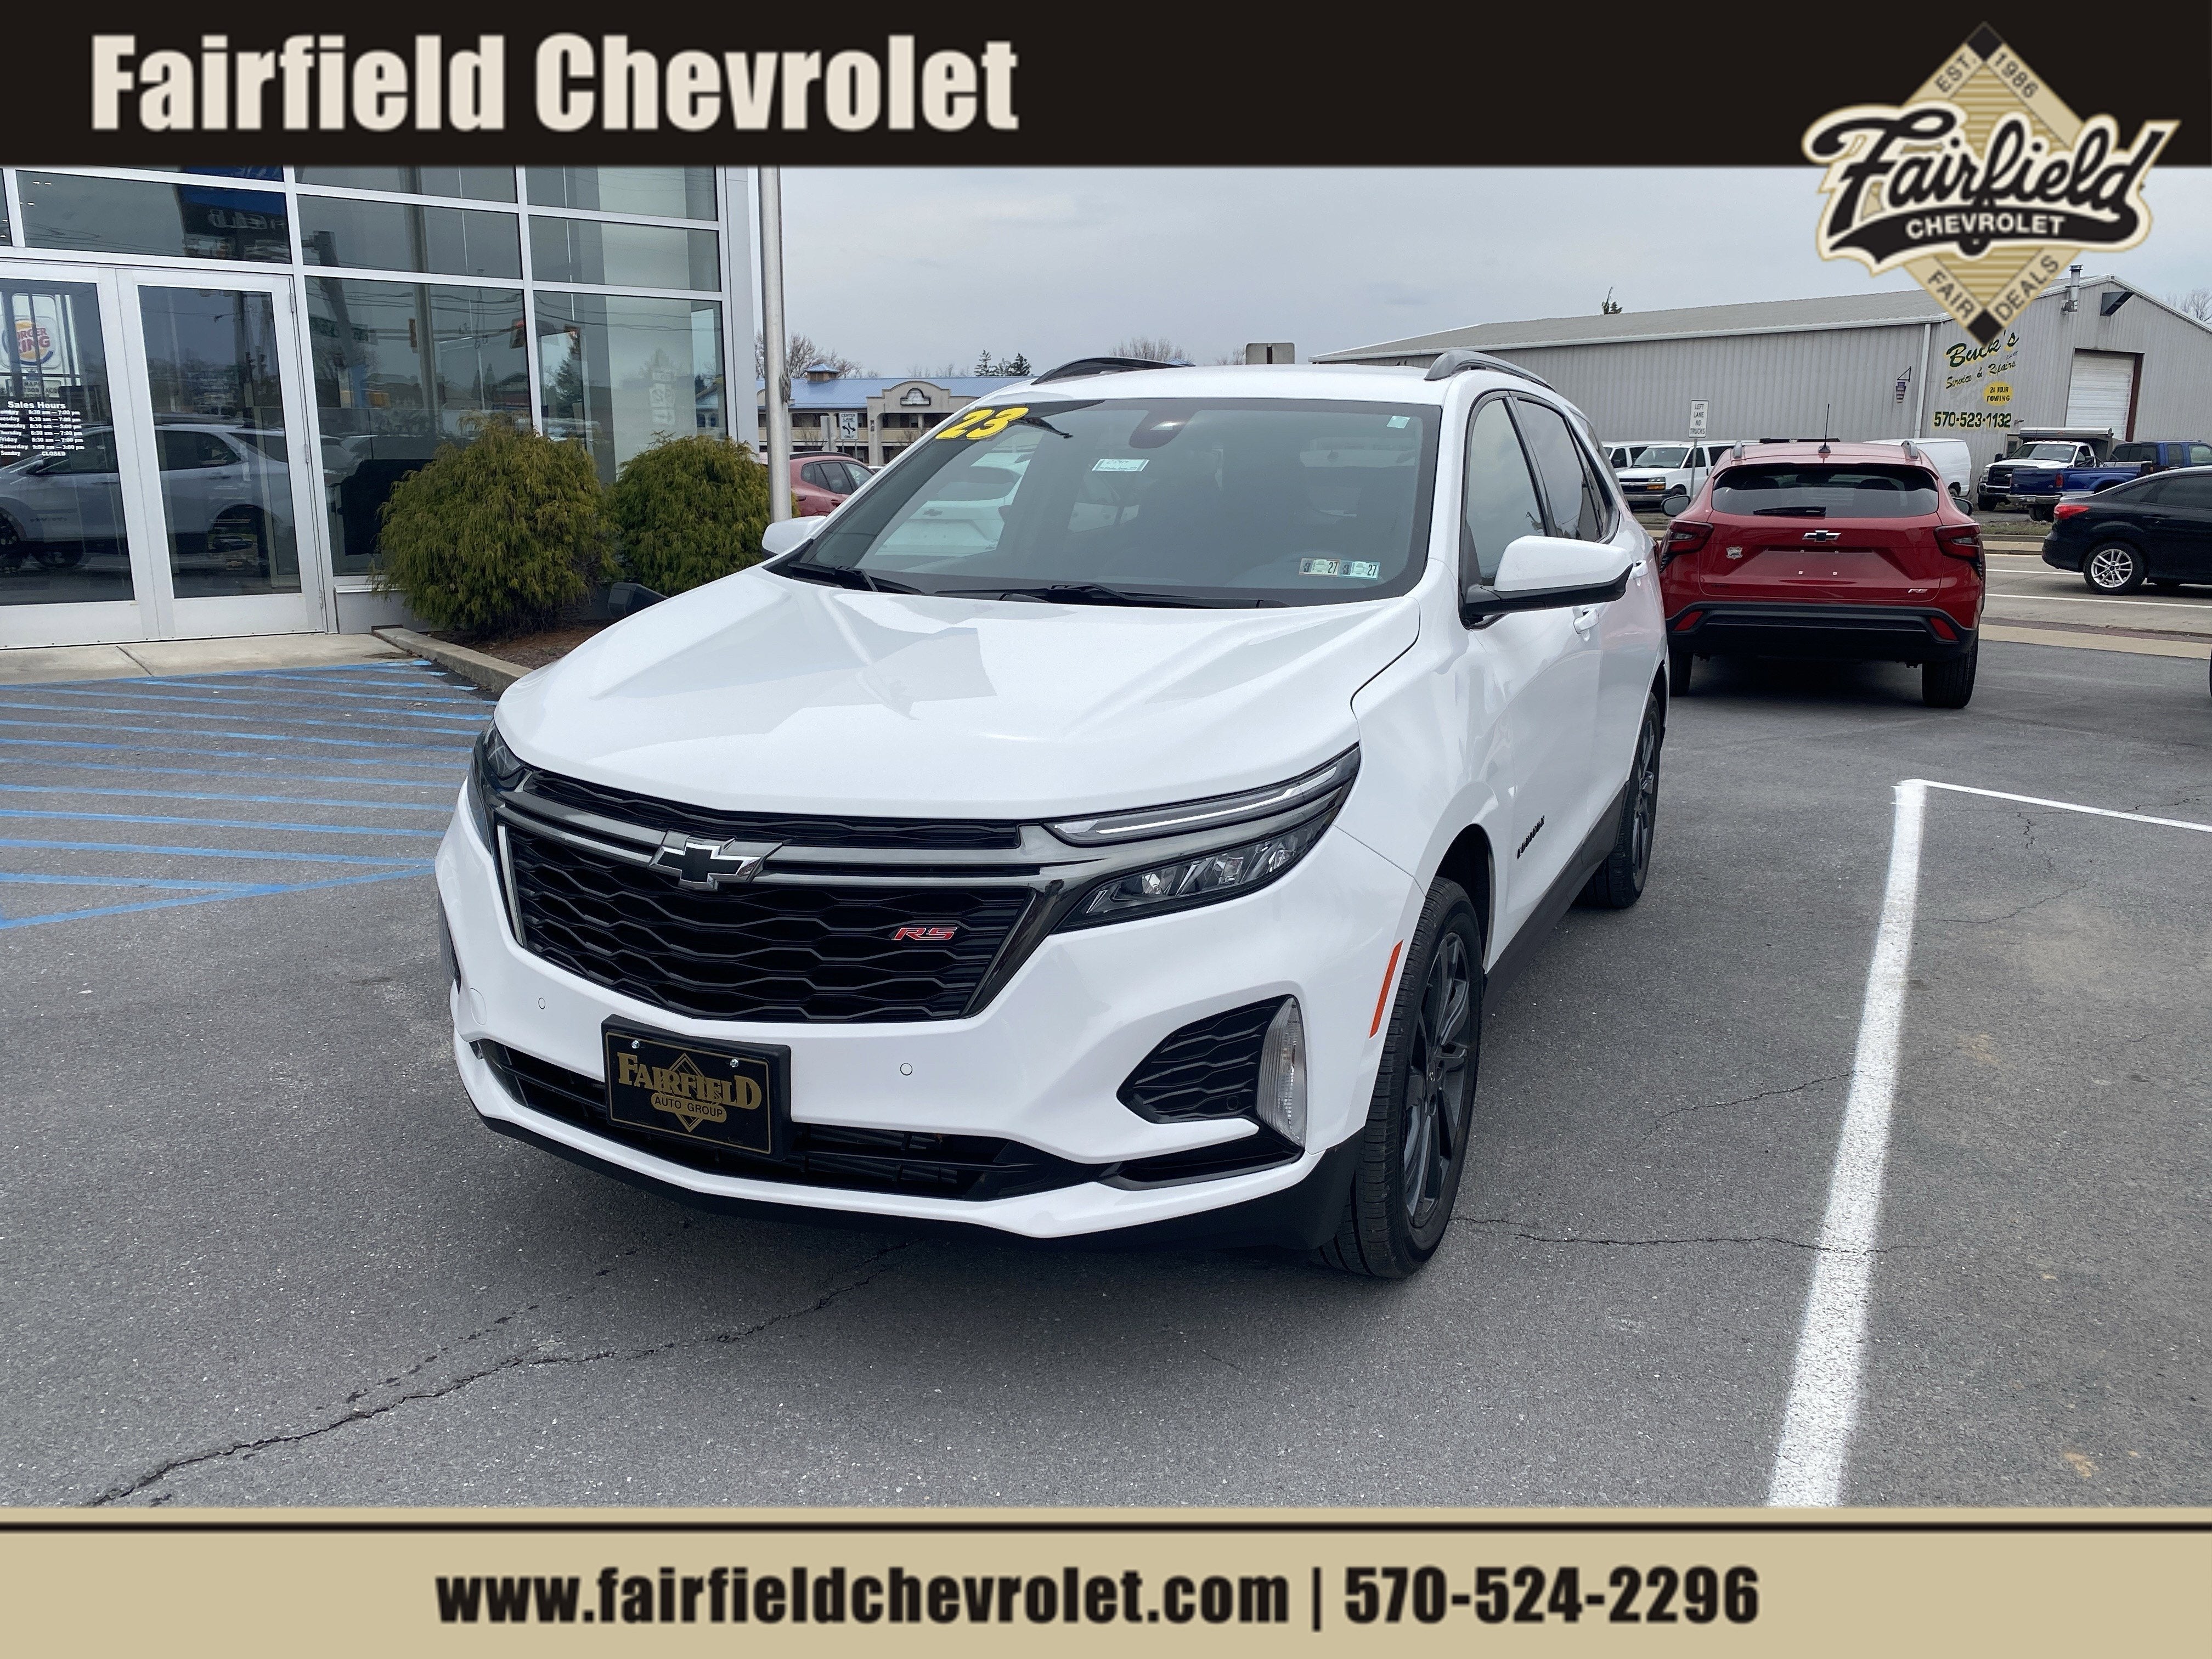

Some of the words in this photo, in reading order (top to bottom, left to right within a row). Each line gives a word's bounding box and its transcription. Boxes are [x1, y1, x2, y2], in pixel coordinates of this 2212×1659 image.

[1946, 375, 1972, 389] Service
[1988, 360, 2017, 376] Repairs
[935, 407, 1029, 440] 23
[1934, 411, 2011, 428] 570-523-1132
[1303, 562, 1311, 572] 3
[1328, 561, 1338, 574] 27
[1367, 564, 1377, 577] 27
[894, 927, 957, 940] RS
[617, 1052, 762, 1110] FAIRFIELD
[654, 1095, 682, 1110] AUTO
[687, 1103, 723, 1118] GROUP
